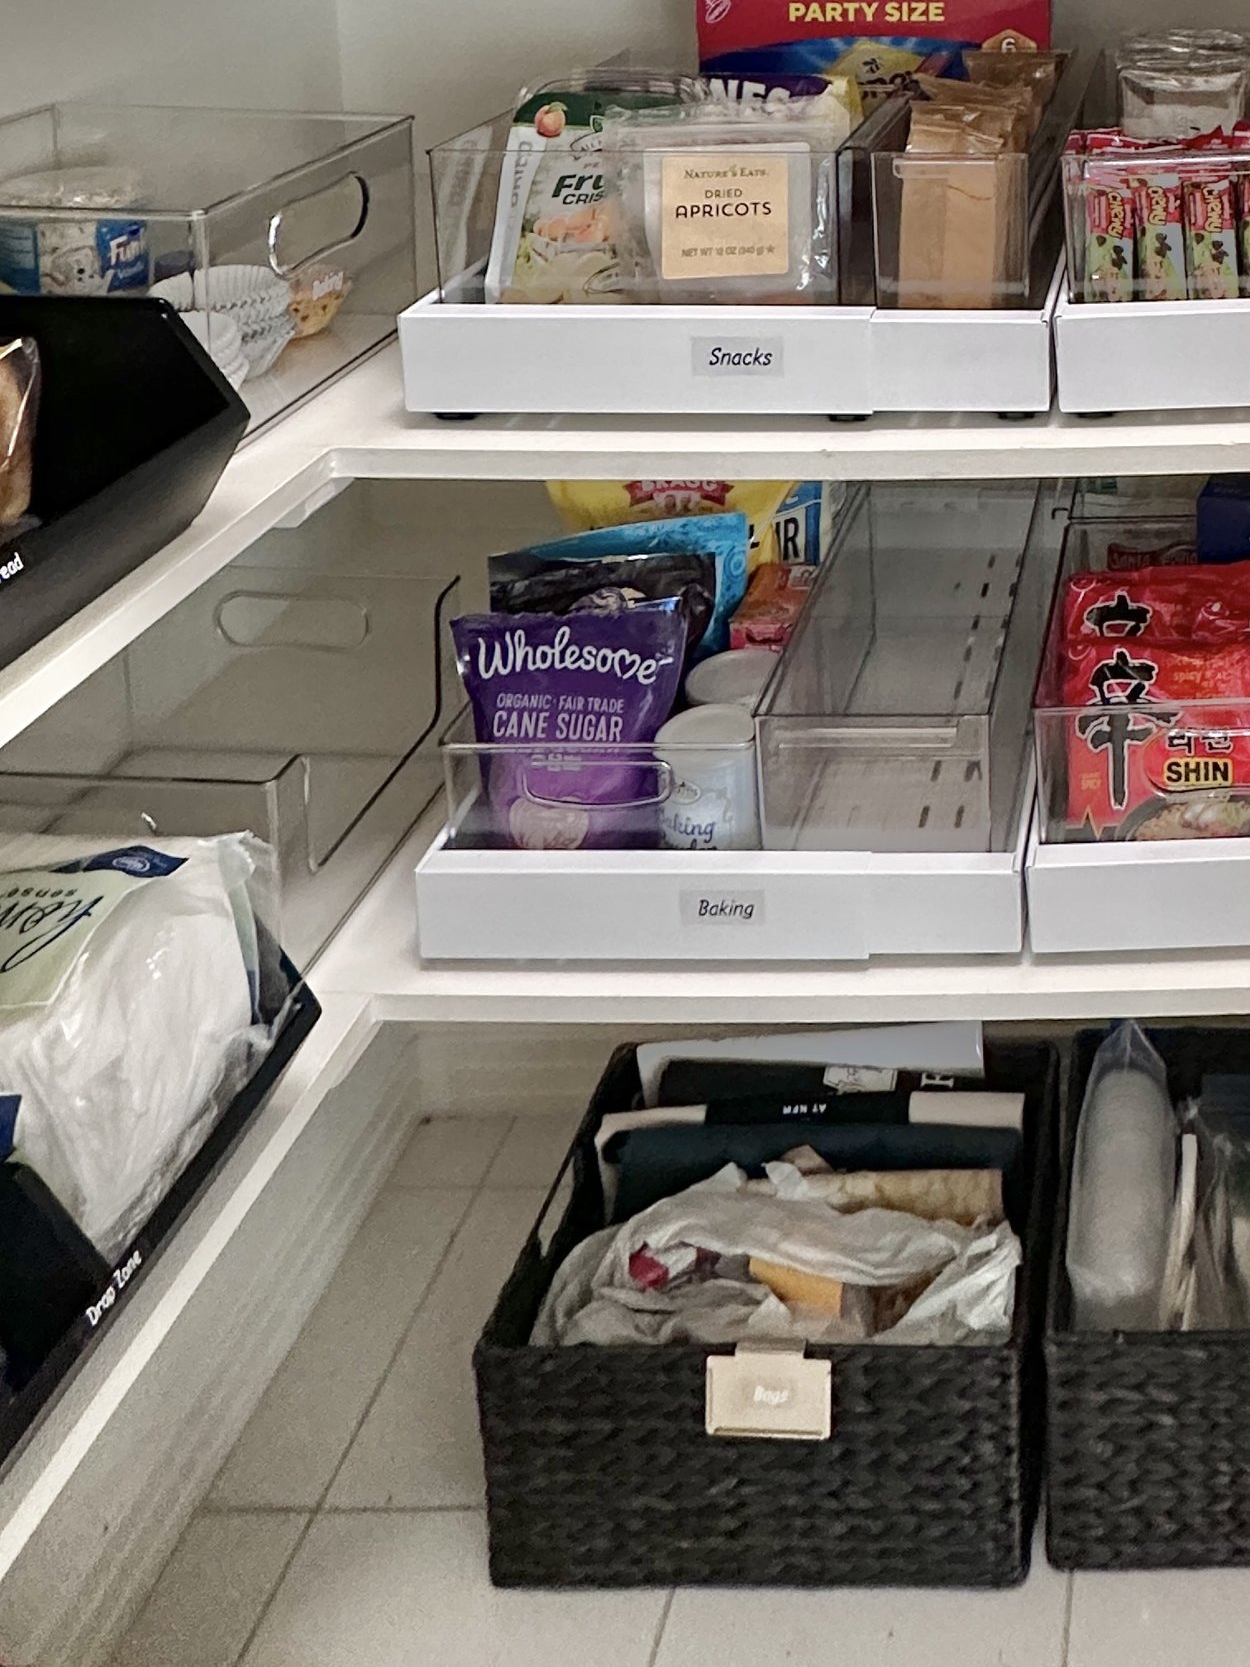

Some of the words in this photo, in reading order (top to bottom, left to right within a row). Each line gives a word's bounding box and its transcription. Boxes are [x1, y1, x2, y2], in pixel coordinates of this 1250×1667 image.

[788, 2, 878, 23] PARTY
[884, 1, 945, 22] SIZE
[740, 167, 768, 177] EATS
[704, 188, 743, 199] DRIED
[675, 201, 772, 219] APRICOTS
[1106, 191, 1125, 239] CHEWY
[1202, 186, 1223, 234] CHEWY
[682, 248, 698, 257] NET
[700, 248, 713, 256] WT
[725, 246, 737, 256] OZ
[709, 346, 773, 368] Snacks
[0, 551, 24, 585] ead
[478, 625, 657, 685] Wholesome
[496, 693, 552, 710] ORGANIC
[558, 695, 585, 711] FAIR
[587, 697, 625, 714] TRADE
[493, 710, 550, 739] CANE
[555, 714, 623, 743] SUGAR
[1075, 647, 1184, 810] 辛
[1165, 760, 1230, 783] SHIN
[664, 814, 716, 844] aking
[698, 898, 755, 920] Baking
[86, 1285, 117, 1327] Drop
[112, 1249, 144, 1290] Zone
[753, 1385, 790, 1404] Bags
